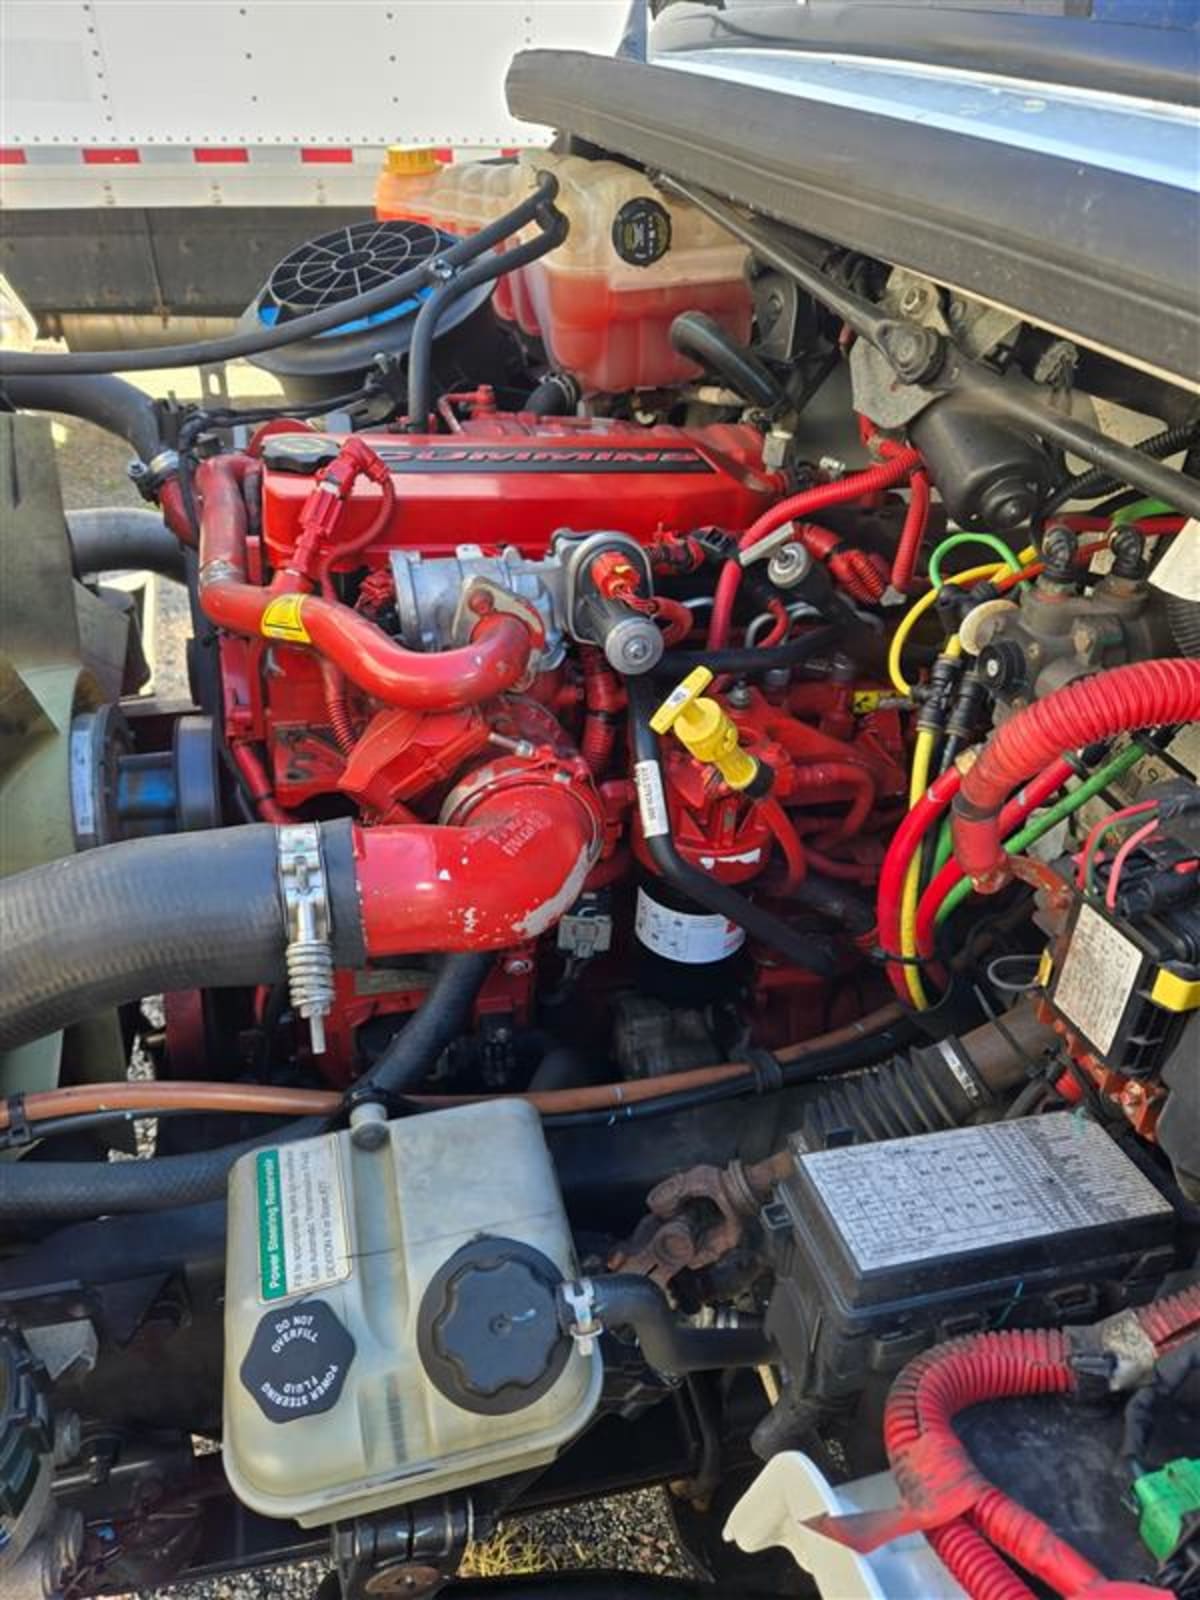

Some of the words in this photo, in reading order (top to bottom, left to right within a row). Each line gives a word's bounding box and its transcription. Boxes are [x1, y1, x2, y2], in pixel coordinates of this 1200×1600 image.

[264, 1158, 277, 1206] Reservoir
[268, 1206, 280, 1252] Steering
[269, 1252, 281, 1289] Power
[271, 1327, 320, 1353] OVERFILL
[275, 1318, 291, 1333] DO
[293, 1315, 314, 1326] NOT
[261, 1381, 309, 1408] STEERING
[283, 1375, 319, 1394] FLUID
[309, 1364, 339, 1401] POWER
